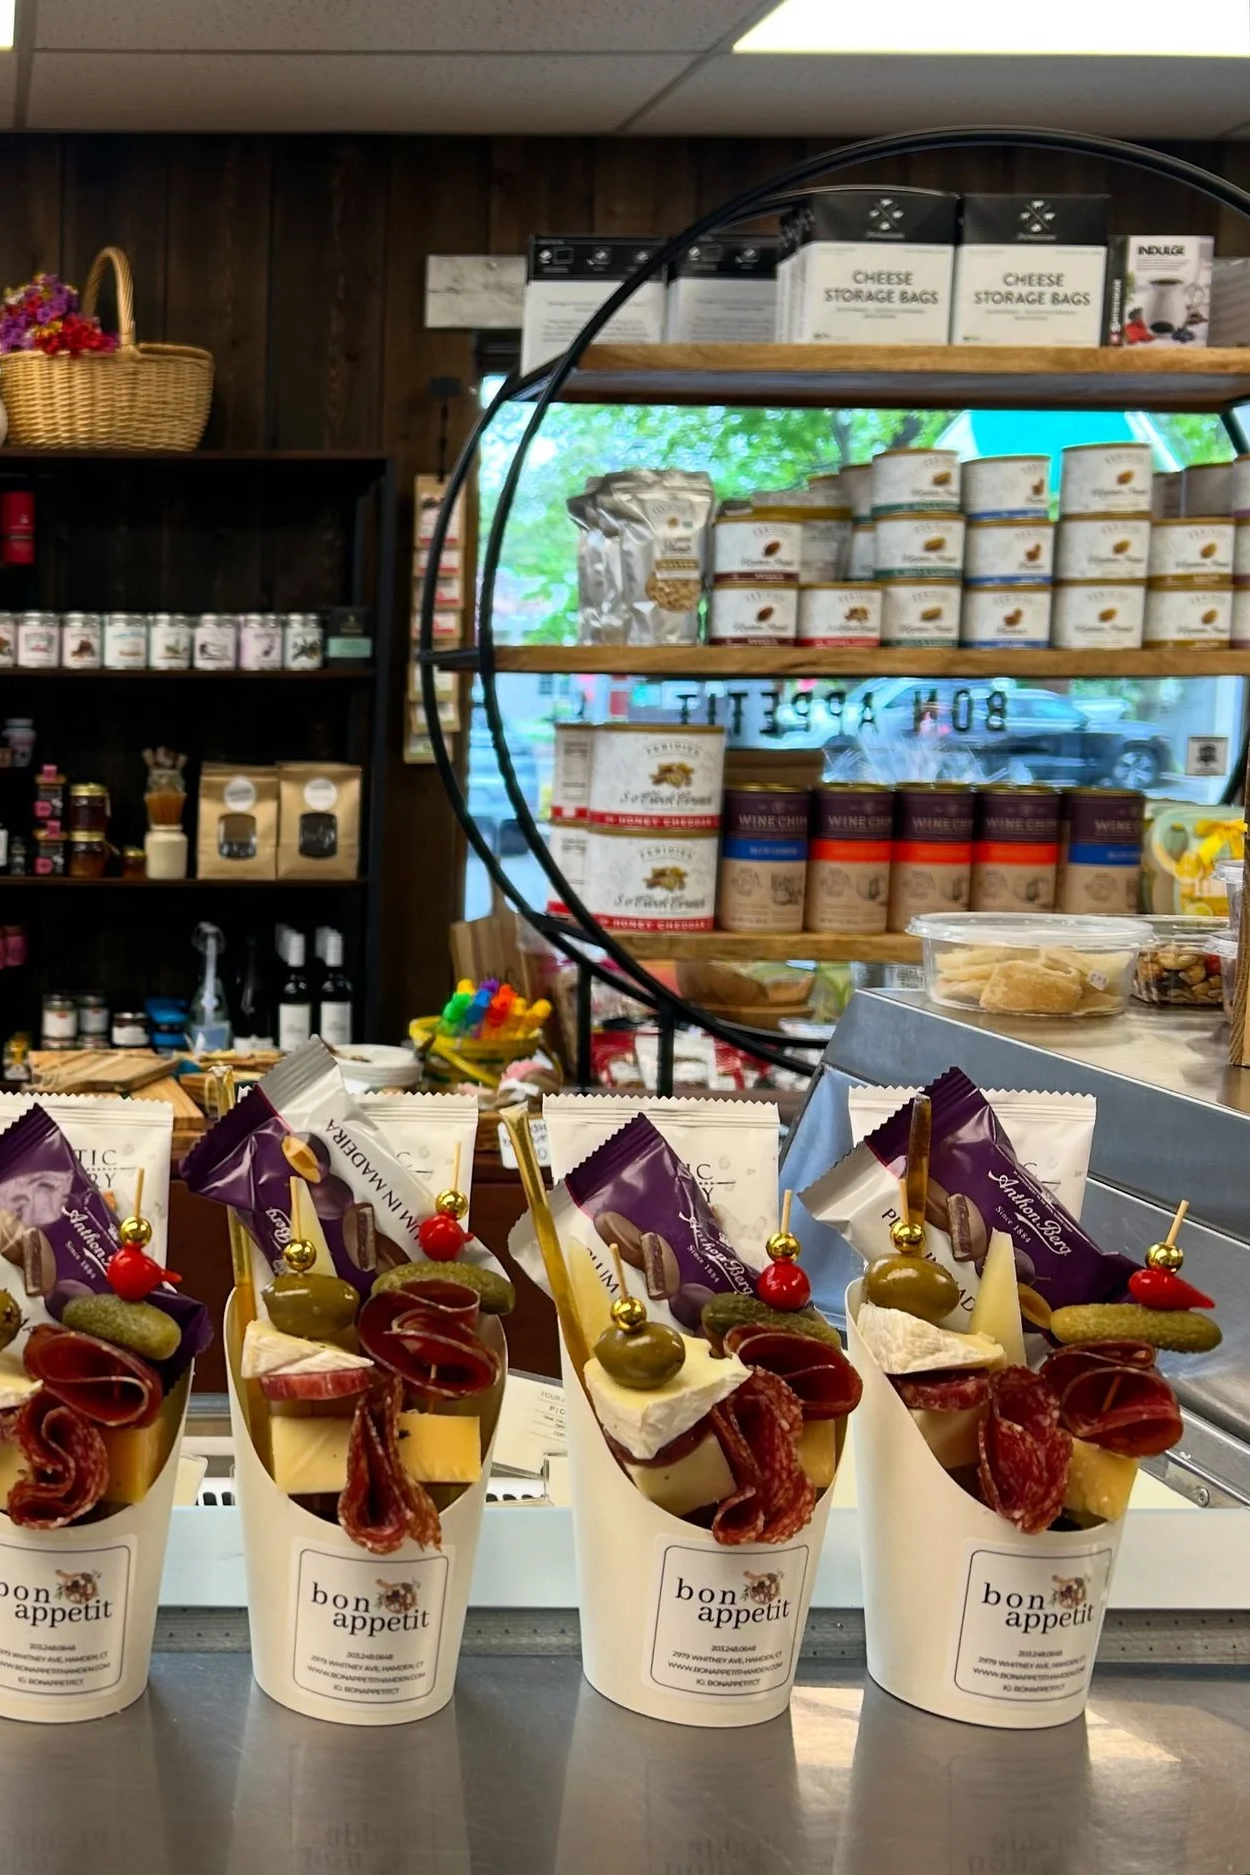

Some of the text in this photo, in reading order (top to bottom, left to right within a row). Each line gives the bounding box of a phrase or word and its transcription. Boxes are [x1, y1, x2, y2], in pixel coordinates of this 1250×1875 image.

[1138, 245, 1186, 255] INDULGE
[852, 269, 913, 286] CHEESE
[1002, 272, 1064, 288] CHEESE
[824, 288, 939, 305] STORAGE BAGS
[974, 291, 1091, 307] STORAGE BAGS
[77, 1149, 117, 1166] TIC
[325, 1118, 388, 1192] MADEIRA
[382, 1189, 403, 1213] IN
[988, 1170, 1041, 1226] Anthon
[1036, 1219, 1073, 1257] Berg
[61, 1205, 107, 1259] Anthon
[995, 1205, 1032, 1244] Since 1884
[64, 1240, 81, 1261] Since
[685, 1244, 721, 1284] Since 1884
[723, 1257, 754, 1296] Berg
[311, 1581, 370, 1613] bon
[675, 1577, 738, 1605] bon
[982, 1582, 1045, 1610] bon
[15, 1600, 113, 1628] appetit
[333, 1609, 430, 1637] appetit
[698, 1600, 791, 1629] appetit
[1005, 1603, 1093, 1634] appetit
[328, 1661, 363, 1671] WHITNEY
[692, 1655, 727, 1664] WHITNEY
